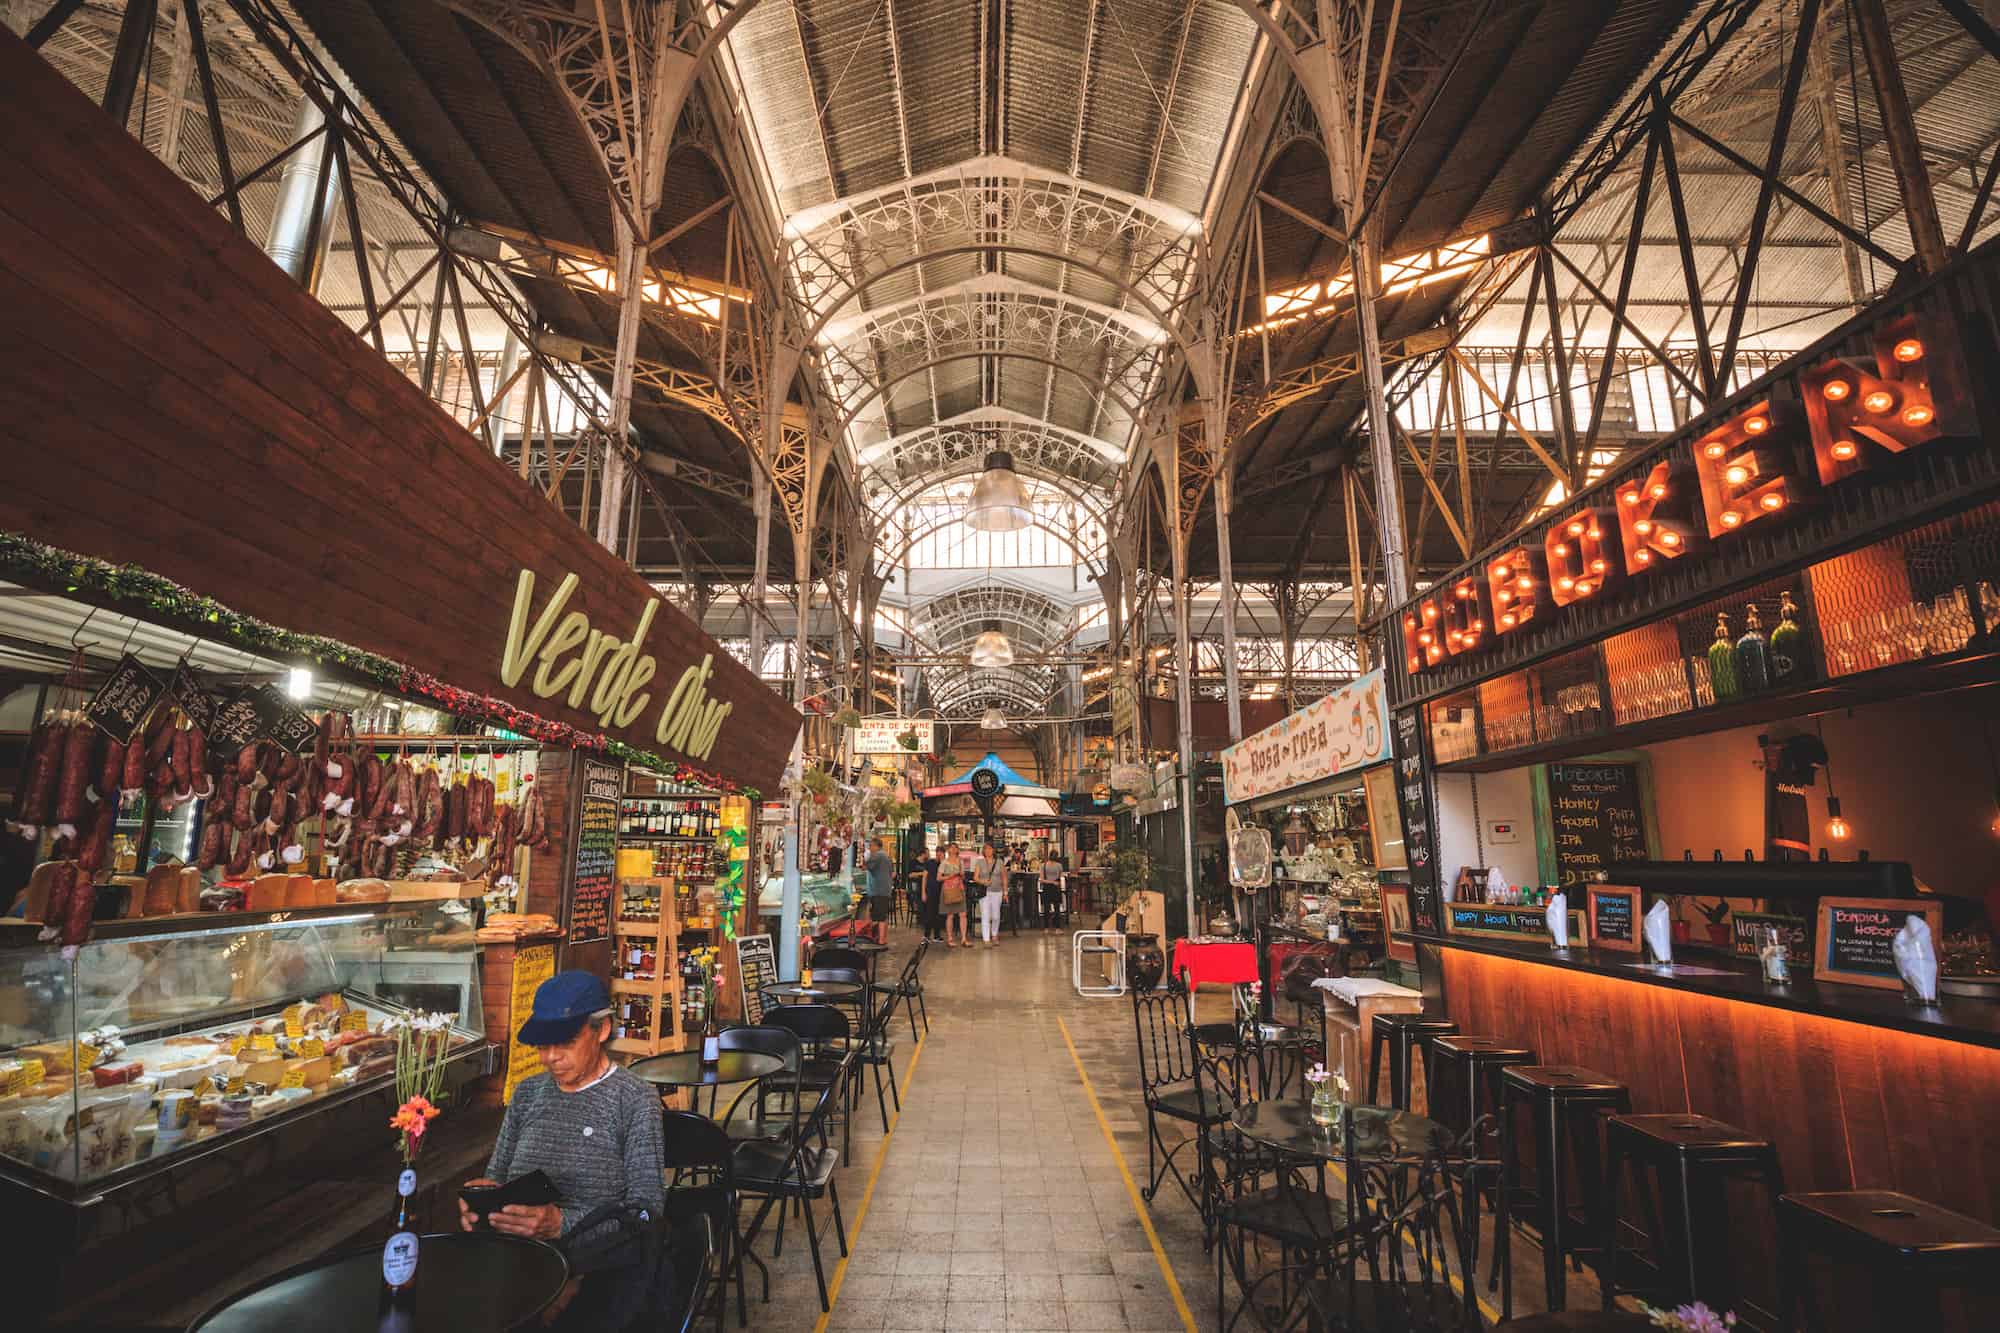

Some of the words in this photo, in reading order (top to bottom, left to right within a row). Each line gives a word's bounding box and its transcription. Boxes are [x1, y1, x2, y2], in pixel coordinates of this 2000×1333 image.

[1403, 313, 1944, 676] HOBOKEN
[501, 569, 659, 728] Verde
[1251, 744, 1280, 777] Rosa
[1455, 911, 1479, 923] HAPPY
[1484, 913, 1510, 926] HOUR
[1836, 911, 1889, 925] BONDIOLA
